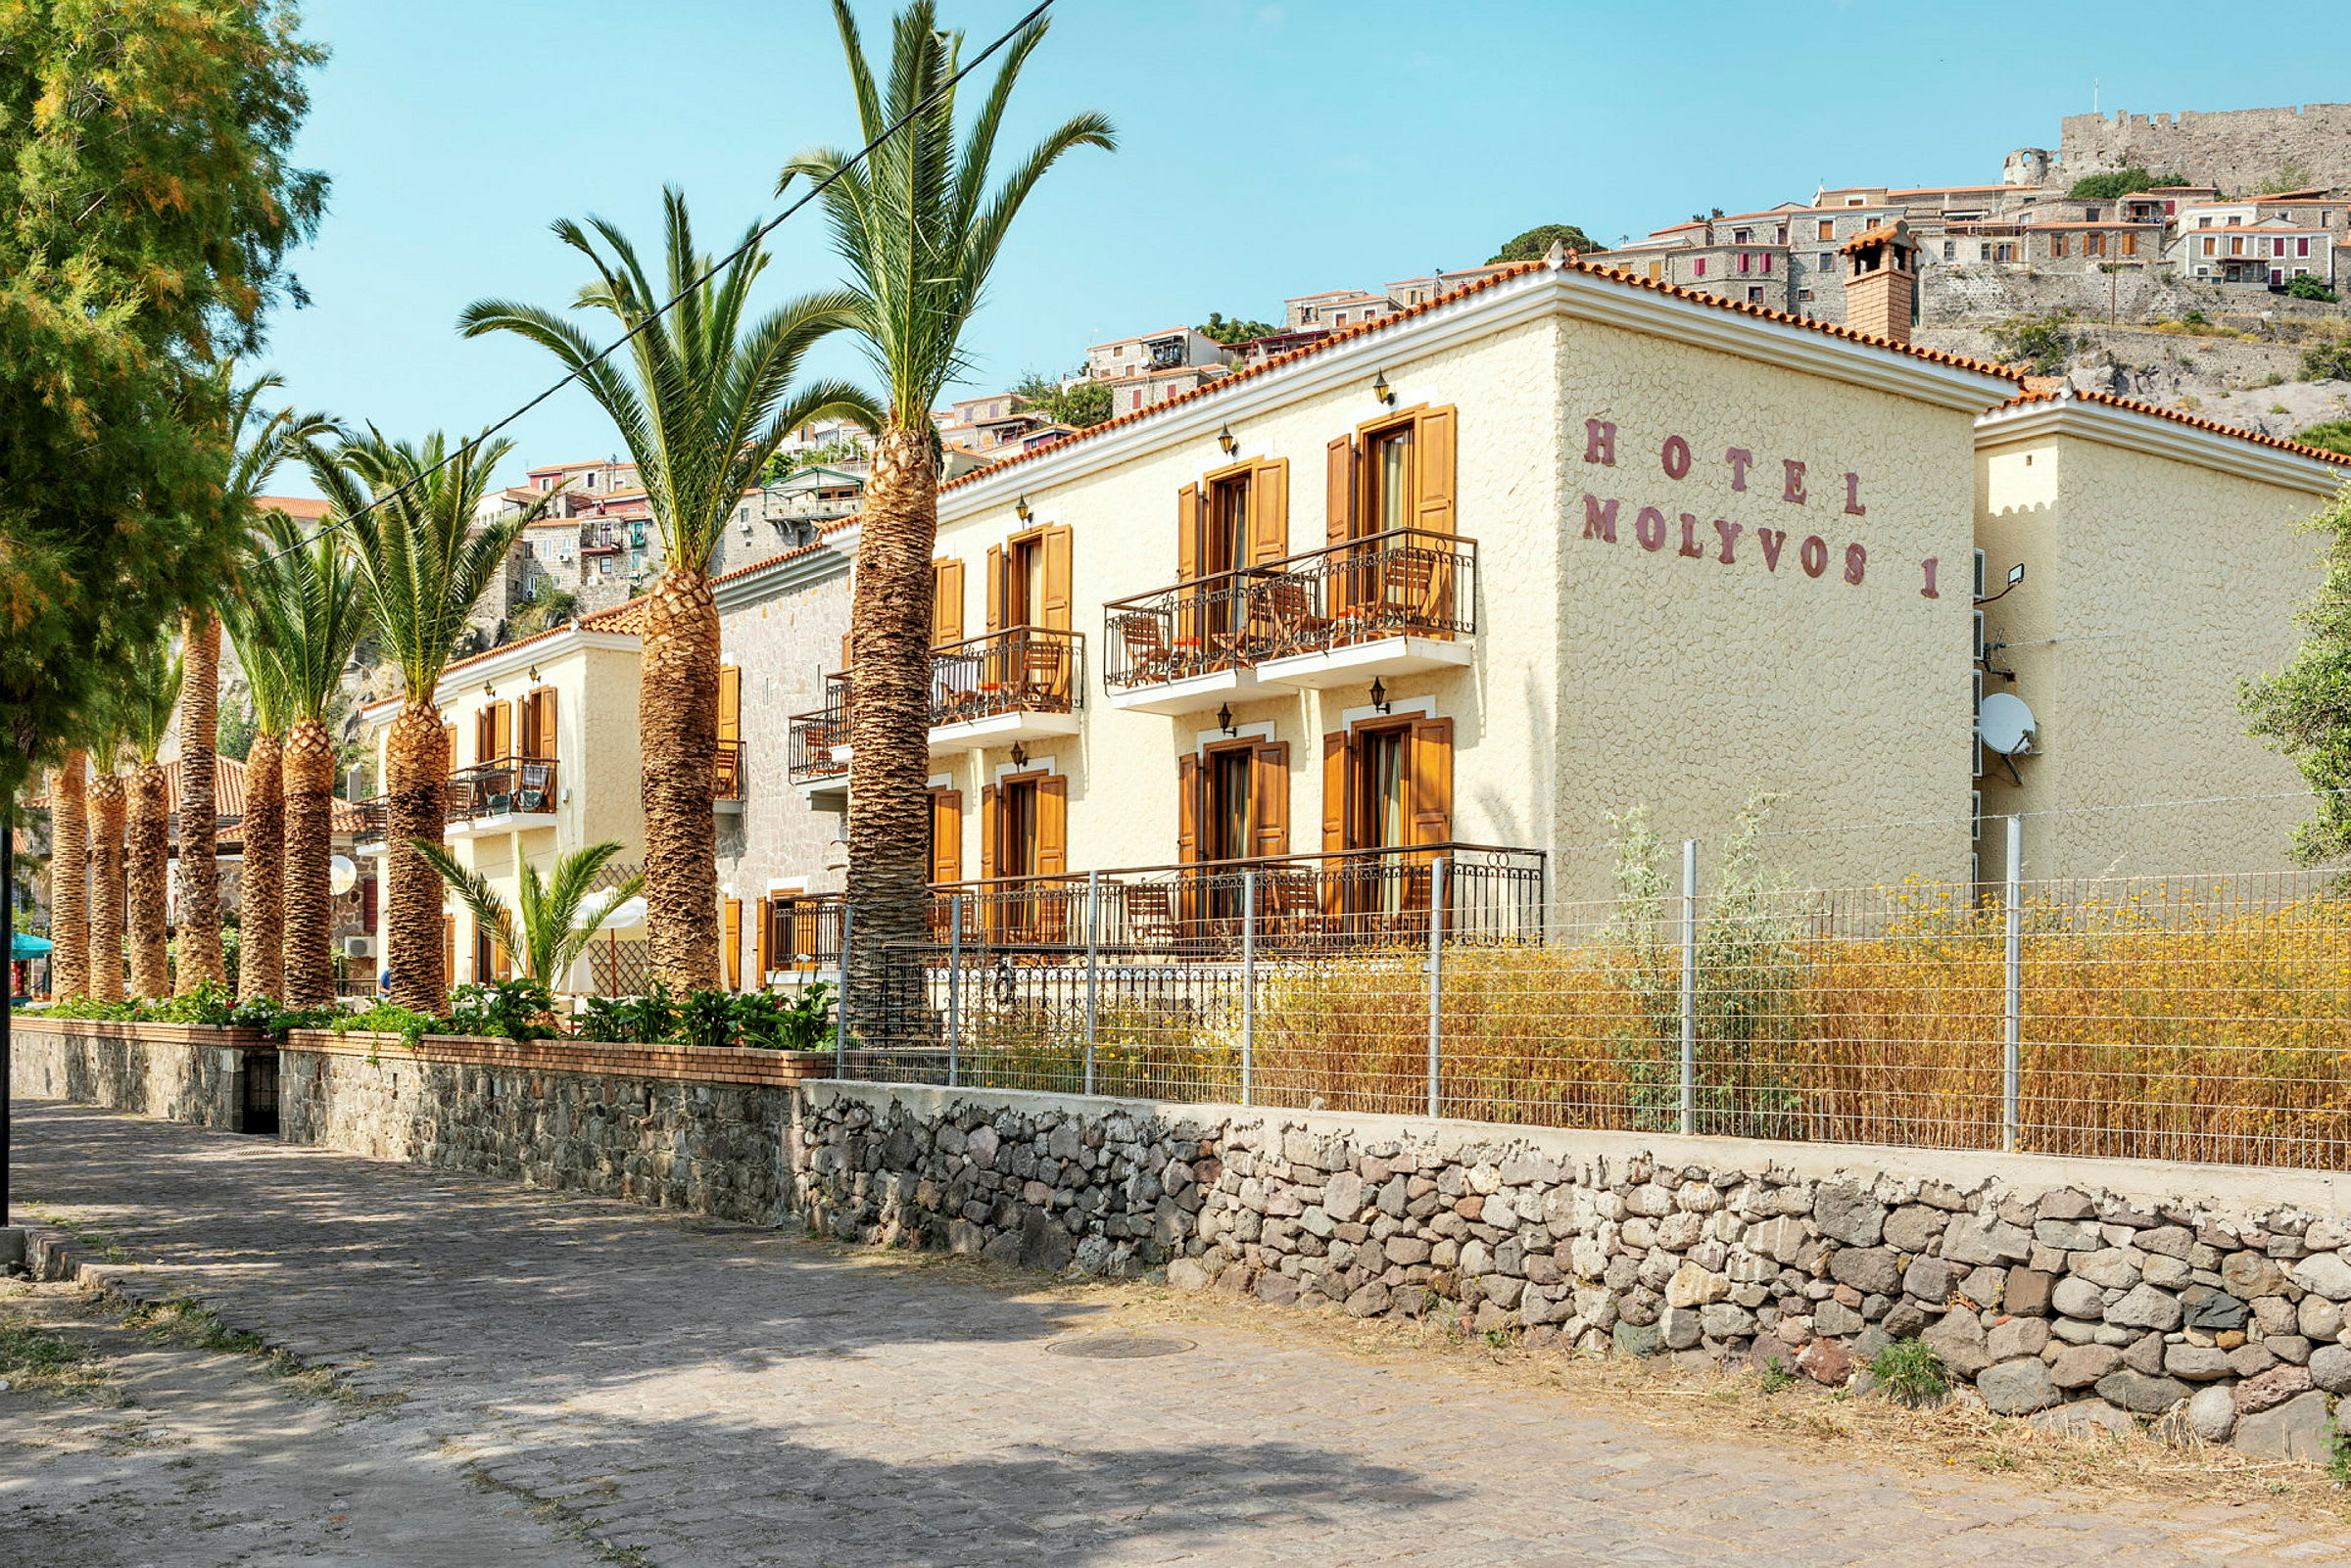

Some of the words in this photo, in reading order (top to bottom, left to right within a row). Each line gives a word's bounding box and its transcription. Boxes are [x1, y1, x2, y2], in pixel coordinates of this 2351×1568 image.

[1584, 418, 1866, 516] HOTEL
[1582, 494, 1867, 586] MOLYVOS
[1920, 557, 1940, 599] 1
